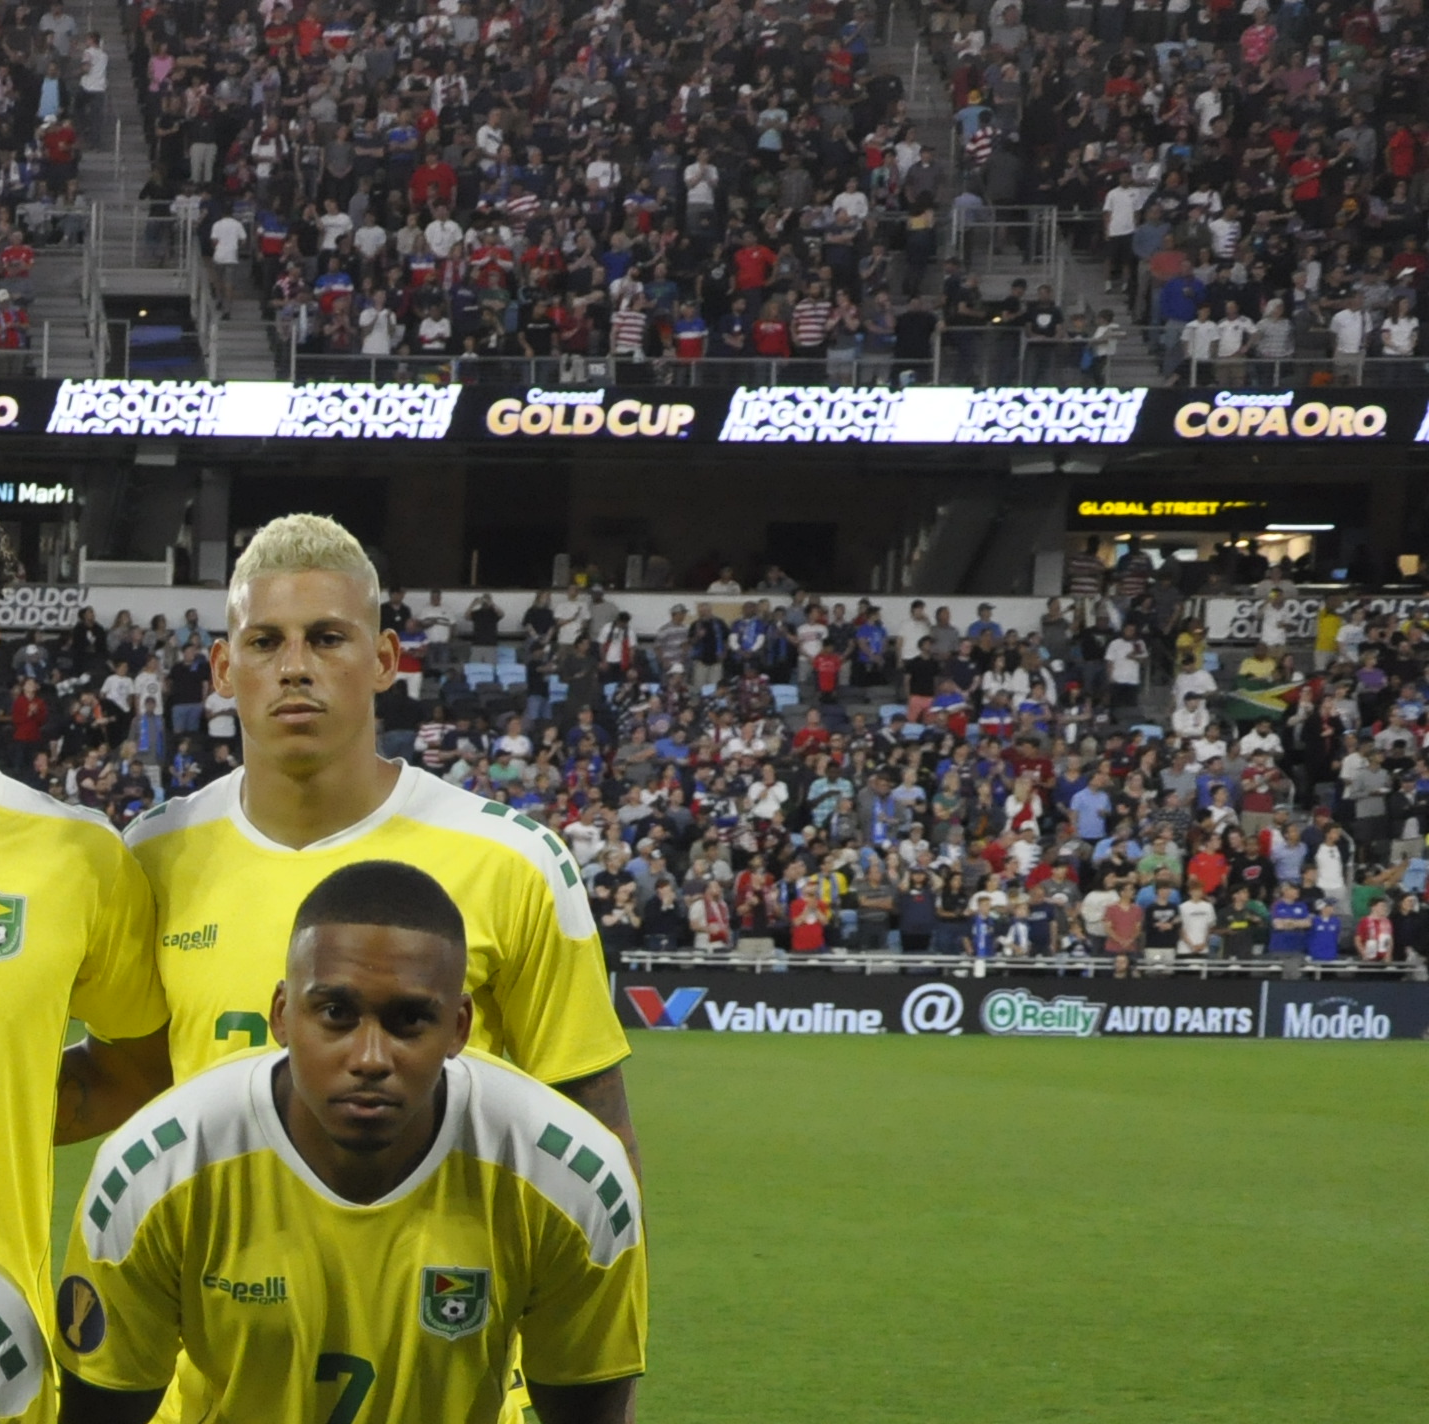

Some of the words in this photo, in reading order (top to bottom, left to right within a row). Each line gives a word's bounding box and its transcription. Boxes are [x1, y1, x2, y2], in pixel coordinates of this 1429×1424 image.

[486, 398, 606, 436] GOLD
[606, 399, 696, 437] CUP
[1174, 402, 1291, 438] COPA
[1291, 402, 1388, 438] ORO
[1078, 501, 1149, 516] GLOBAL
[1151, 501, 1220, 516] STREET
[162, 923, 219, 950] capelli
[704, 1001, 884, 1034] Valvoline
[988, 990, 1099, 1033] O'Reilly
[1104, 1006, 1170, 1033] AUTO
[1174, 1006, 1253, 1034] PARTS
[1283, 1002, 1391, 1040] Modelo
[203, 1275, 287, 1302] capelli
